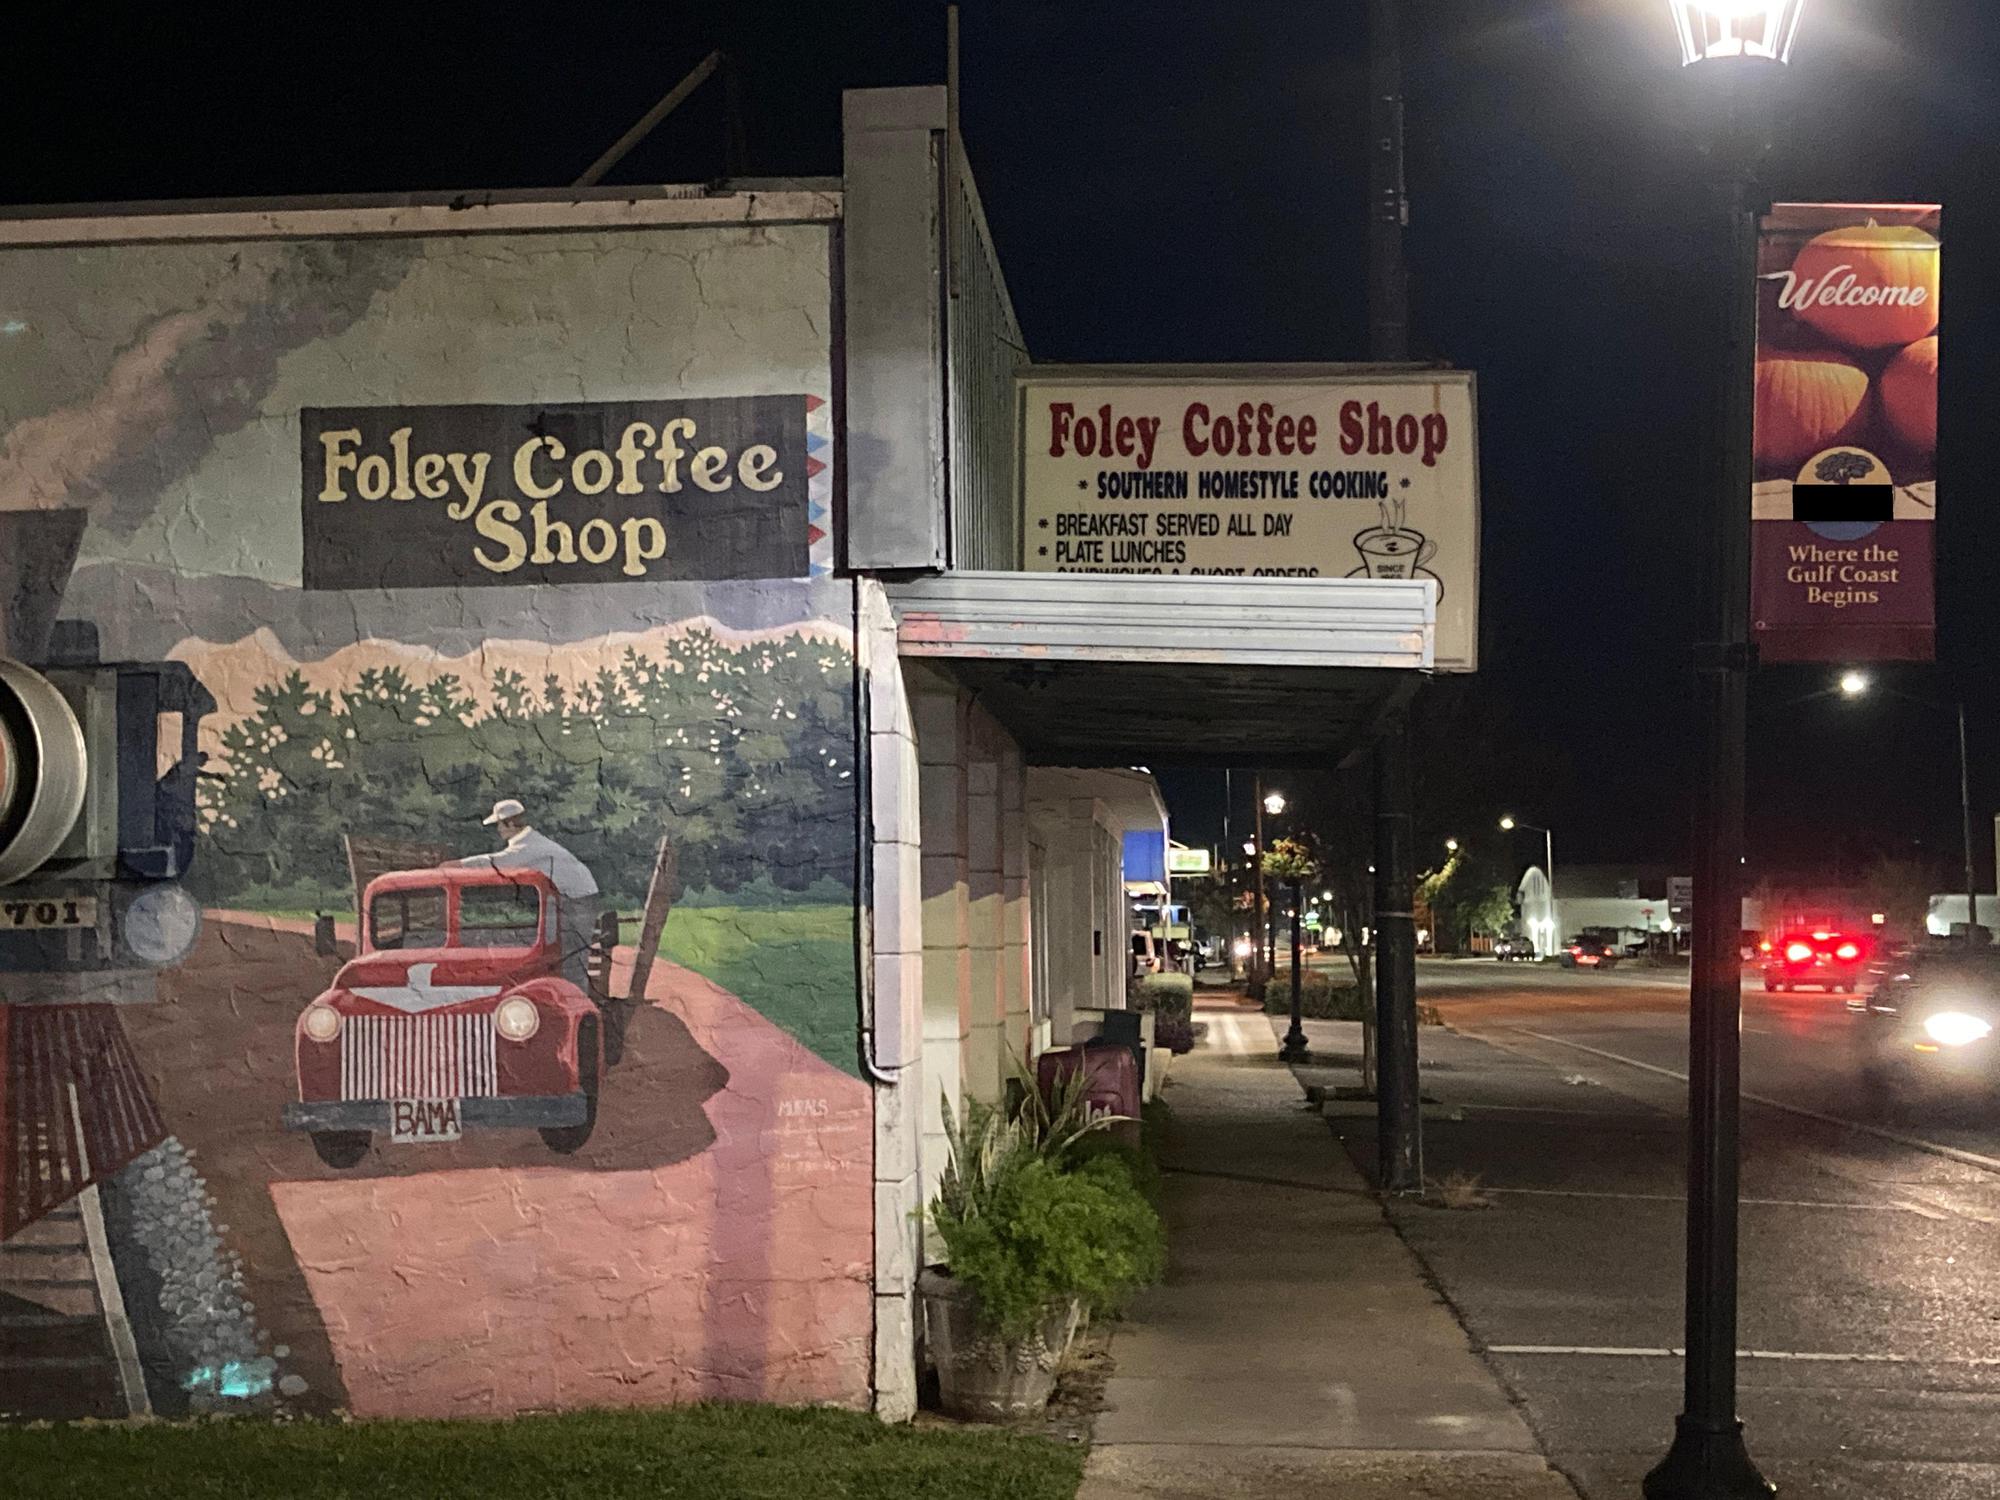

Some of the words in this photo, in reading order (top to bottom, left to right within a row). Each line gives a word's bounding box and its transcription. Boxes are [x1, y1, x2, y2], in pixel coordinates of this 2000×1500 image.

[1757, 265, 1928, 311] Welcome
[1049, 402, 1161, 469] Foley
[1183, 401, 1317, 457] Coffee
[1339, 400, 1447, 467] Shop
[318, 427, 491, 520] Foley
[513, 418, 783, 498] Coffee
[1097, 471, 1188, 499] SOUTHERN
[1200, 471, 1299, 499] HOMESTYLE
[1309, 471, 1388, 499] COOKING
[1056, 514, 1149, 537] BREAKFAST
[1156, 513, 1220, 537] SERVED
[1227, 513, 1257, 537] ALL
[1263, 513, 1293, 537] DAY
[473, 500, 667, 576] Shop
[1056, 540, 1104, 563] PLATE
[1111, 541, 1186, 563] LUNCHES
[1788, 544, 1858, 562] Where
[1864, 544, 1899, 562] the
[1377, 565, 1405, 573] SINCE
[1787, 565, 1835, 583] Gulf
[1840, 565, 1899, 583] Coast
[1808, 586, 1879, 608] Begins
[5, 902, 80, 924] 701
[394, 1099, 460, 1136] BAMA
